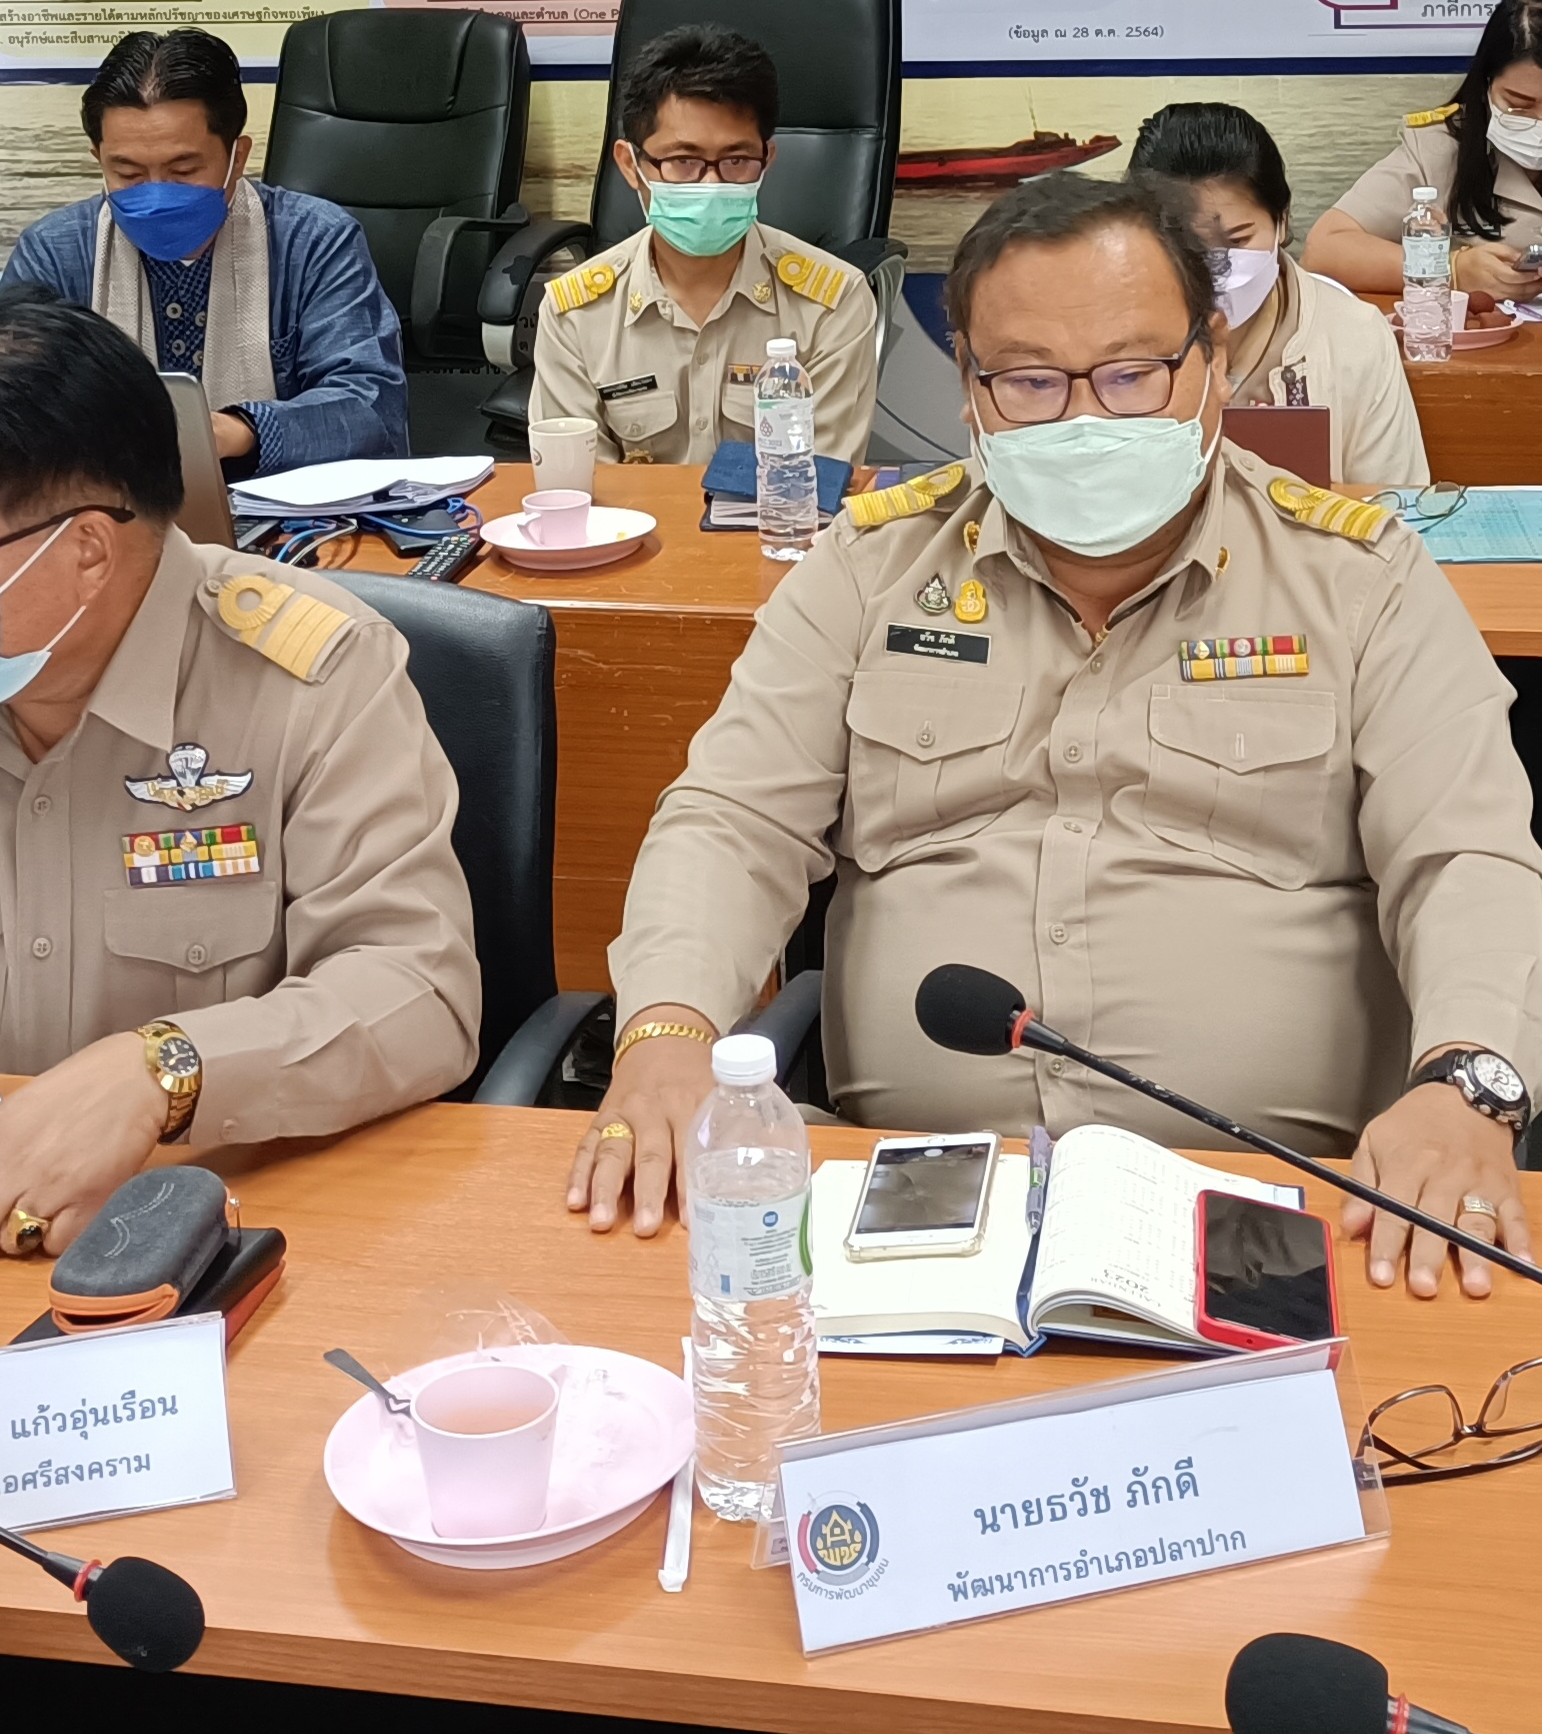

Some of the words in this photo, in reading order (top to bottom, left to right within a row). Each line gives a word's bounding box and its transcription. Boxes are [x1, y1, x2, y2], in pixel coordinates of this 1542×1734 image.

[1055, 27, 1066, 38] ณ
[11, 1388, 179, 1445] แก้วอุ่นเรือน
[974, 1476, 1111, 1536] นายธวัช
[1127, 1456, 1200, 1509] ภักดี
[947, 1528, 1247, 1602] พัฒนาการอำเภอปลาปาก
